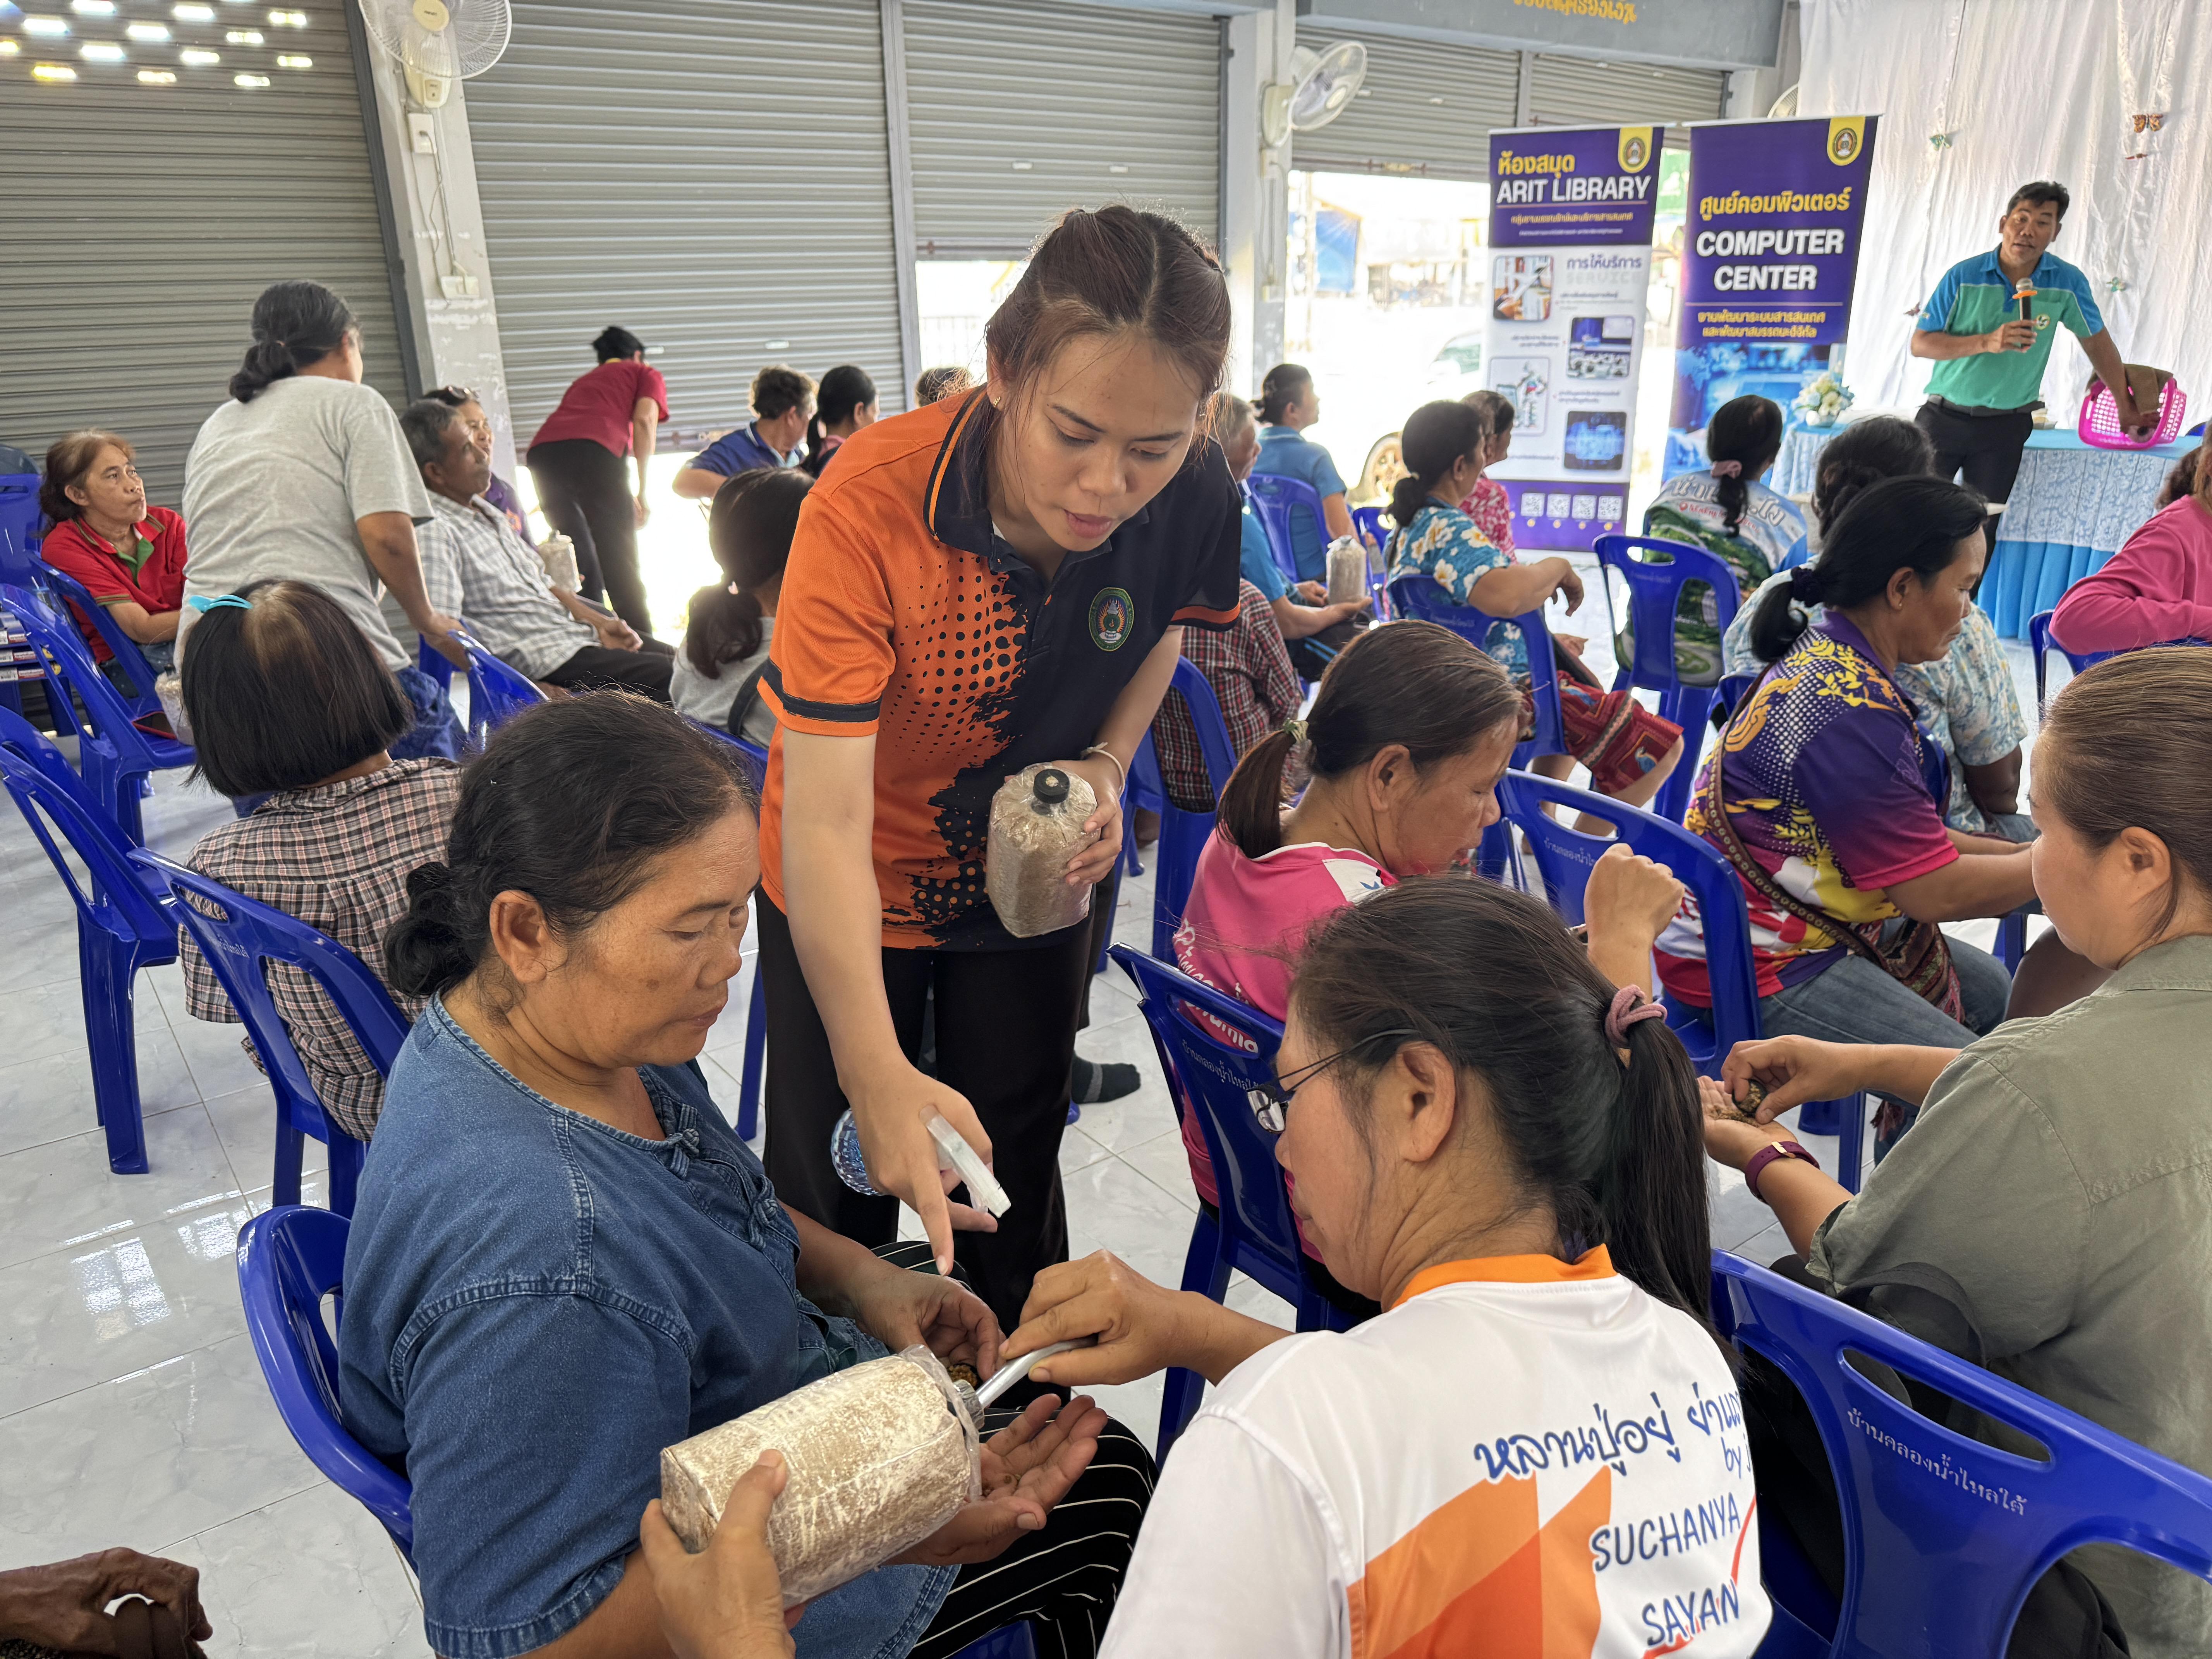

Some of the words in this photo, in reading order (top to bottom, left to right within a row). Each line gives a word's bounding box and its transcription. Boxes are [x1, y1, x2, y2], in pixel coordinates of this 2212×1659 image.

[1498, 150, 1575, 179] ห้องสมุด
[1496, 179, 1548, 204] ARIT
[1552, 176, 1652, 203] LIBRARY
[1700, 187, 1853, 221] ศูนย์คอมพิวเตอร์
[1696, 228, 1845, 257] COMPUTER
[1714, 264, 1819, 291] CENTER
[1474, 1391, 1681, 1479] หลานปู่อยู่
[1721, 1436, 1742, 1479] by
[1847, 1407, 2028, 1516] บ้านคลองน้ำไหลใต้
[1589, 1492, 1741, 1571] SUCHANYA
[1642, 1580, 1740, 1647] SAYAN
